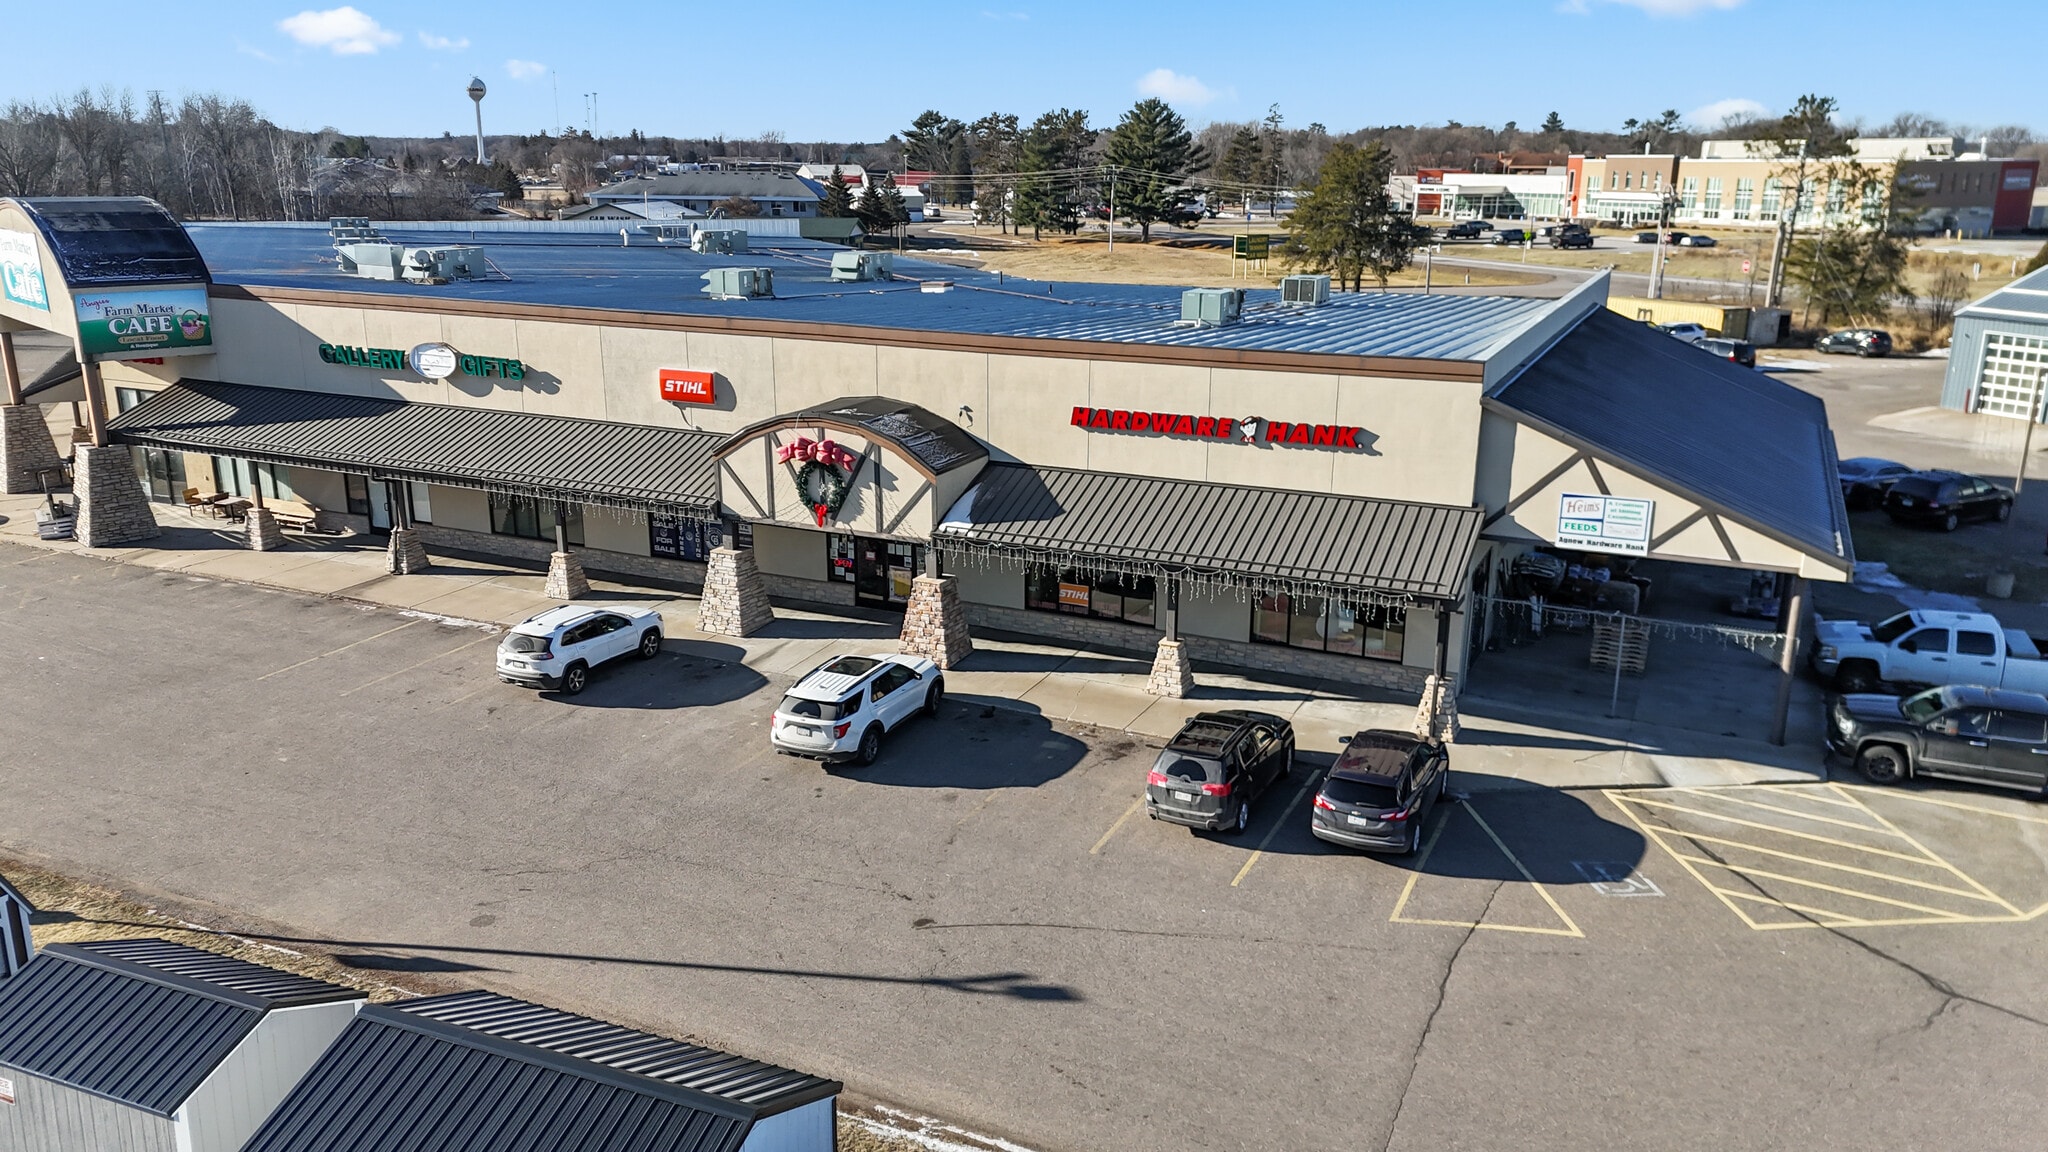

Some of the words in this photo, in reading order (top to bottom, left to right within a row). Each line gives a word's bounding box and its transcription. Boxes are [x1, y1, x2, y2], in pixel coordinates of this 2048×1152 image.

[104, 306, 132, 316] Farm
[136, 304, 174, 315] Market
[108, 316, 173, 335] CAFE
[319, 344, 405, 369] GALLERY
[460, 354, 525, 380] GIFTS
[664, 379, 707, 395] STIHL
[1070, 406, 1233, 439] HARDWARE
[1564, 522, 1597, 532] FEEDS
[654, 545, 676, 553] SALE
[1587, 540, 1622, 549] Hardware
[1060, 589, 1089, 601] STIHL
